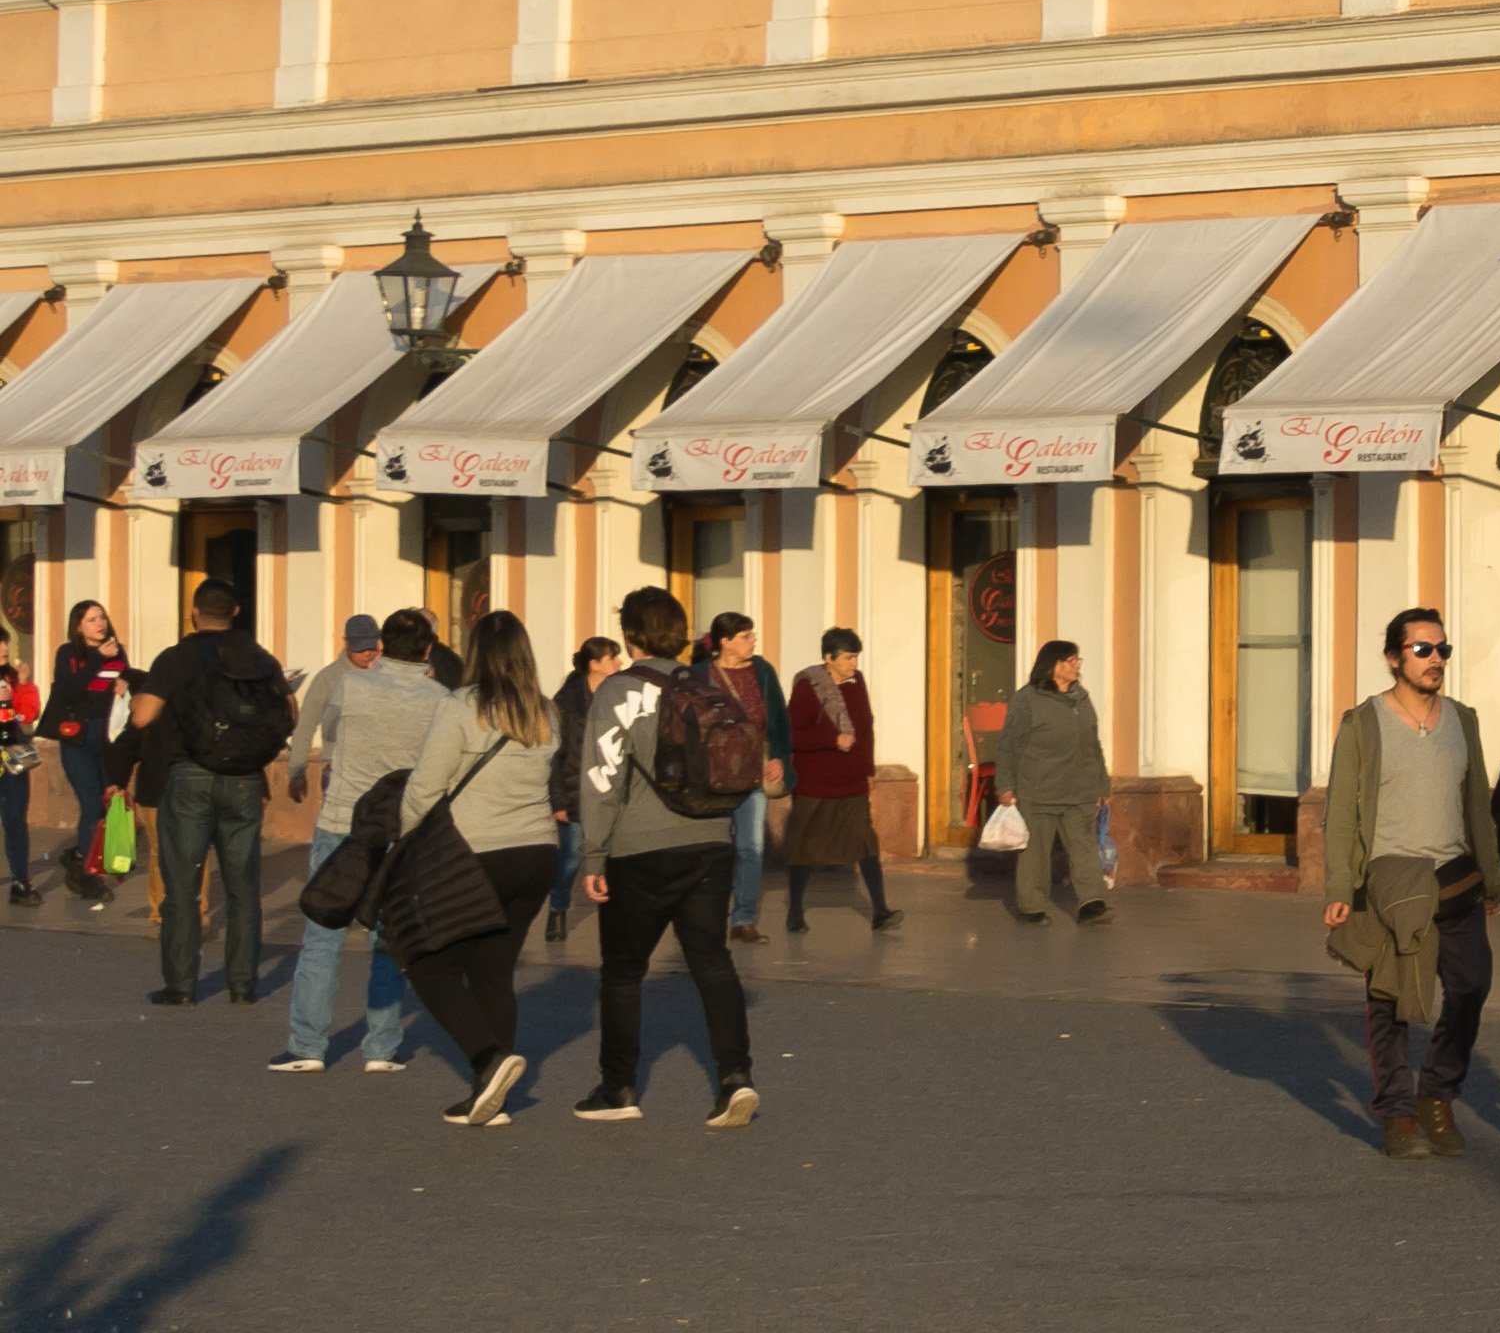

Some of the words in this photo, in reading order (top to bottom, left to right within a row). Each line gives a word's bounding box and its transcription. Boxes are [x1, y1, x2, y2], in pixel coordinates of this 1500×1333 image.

[684, 437, 725, 457] El
[722, 442, 809, 483] Galeón
[963, 431, 1007, 451] El
[1004, 434, 1098, 477] Galeón
[1279, 416, 1325, 437] El
[1322, 420, 1424, 465] Galeón
[1357, 452, 1408, 462] RESTAURANT
[0, 464, 49, 484] aleón
[451, 449, 531, 488] Galeón
